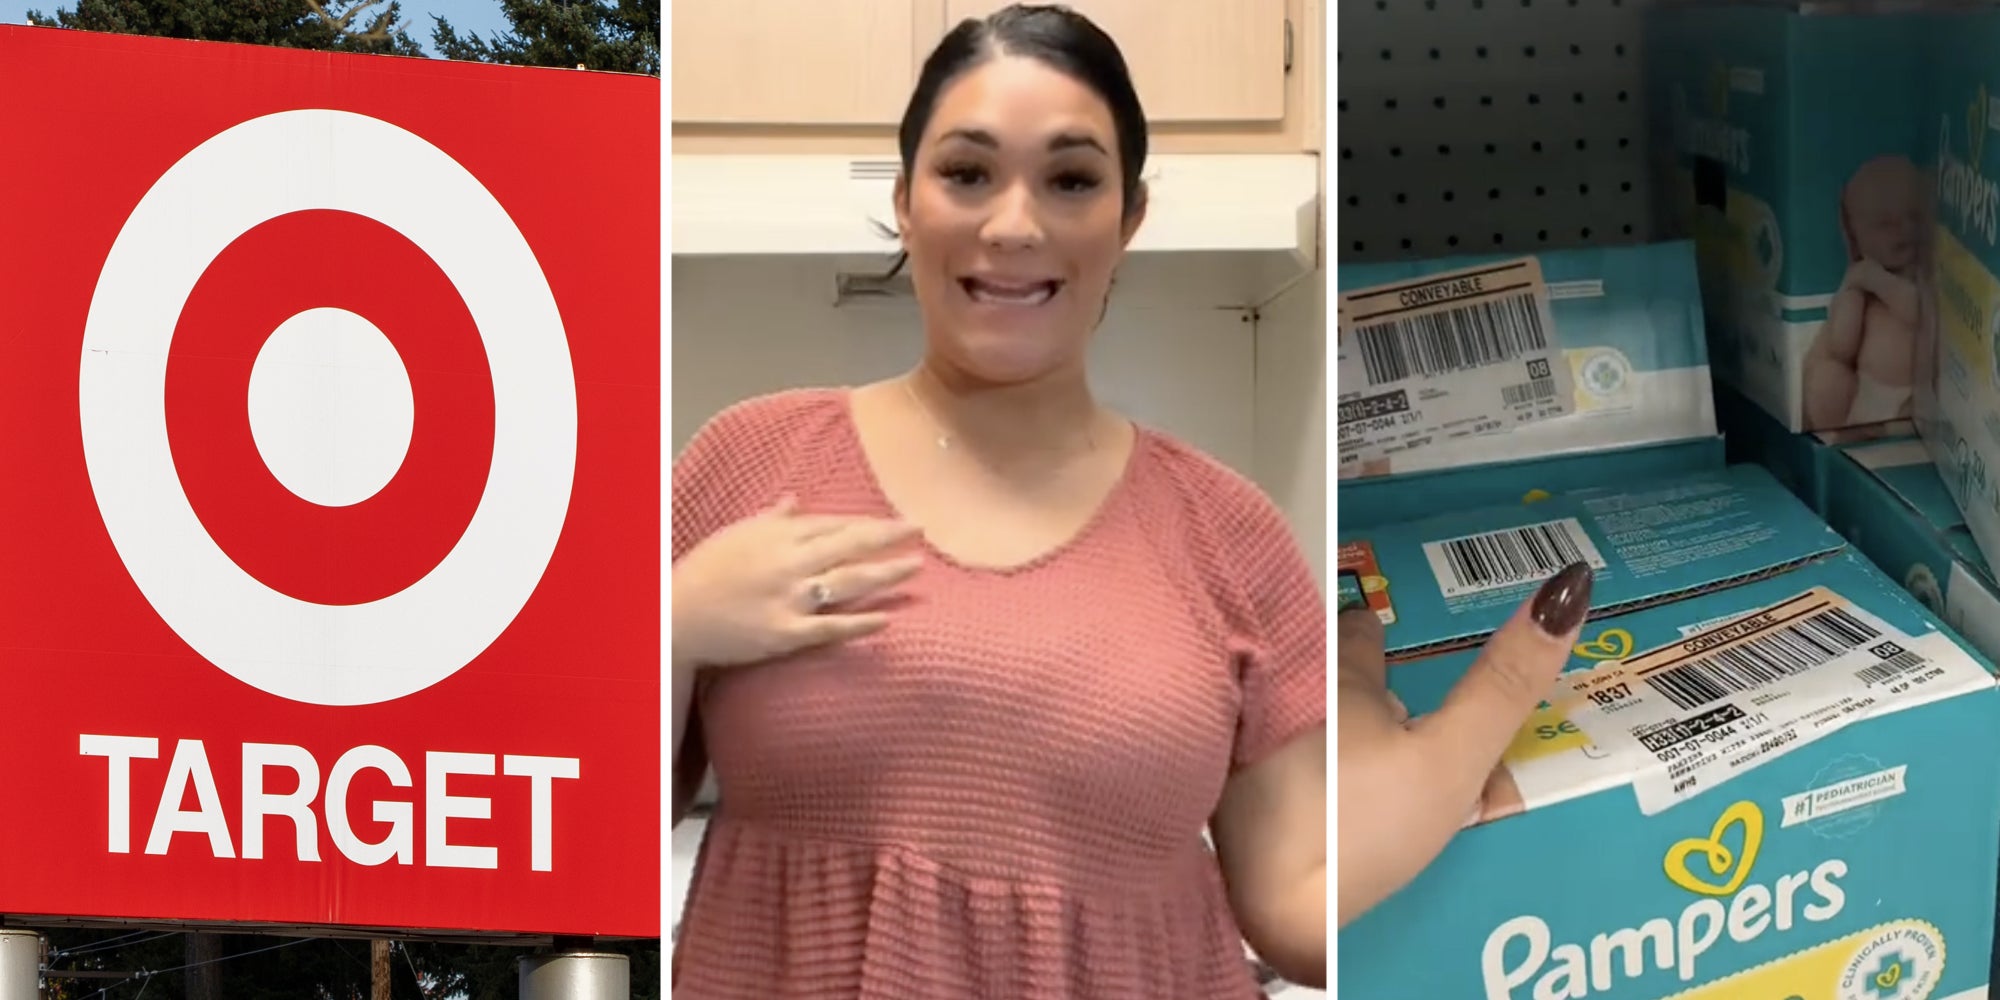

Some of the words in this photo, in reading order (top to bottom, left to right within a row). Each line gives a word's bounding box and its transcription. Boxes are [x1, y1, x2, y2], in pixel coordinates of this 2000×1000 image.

[1399, 277, 1483, 306] CONVEYABLE
[1530, 361, 1549, 377] 08
[1683, 612, 1777, 653] CONVEYABLE
[1874, 642, 1899, 658] 08
[1587, 682, 1633, 706] 1837
[1643, 706, 1742, 752] H33(1)-2-4-2
[1656, 724, 1738, 763] 007-07-0044
[79, 733, 580, 872] TARGET
[1794, 792, 1814, 817] #1
[1815, 772, 1897, 803] PEDIATRICIAN
[1481, 858, 1848, 1000] Pampers
[1841, 929, 1902, 989] CLINICALLY
[1903, 929, 1937, 960] PROVEN
